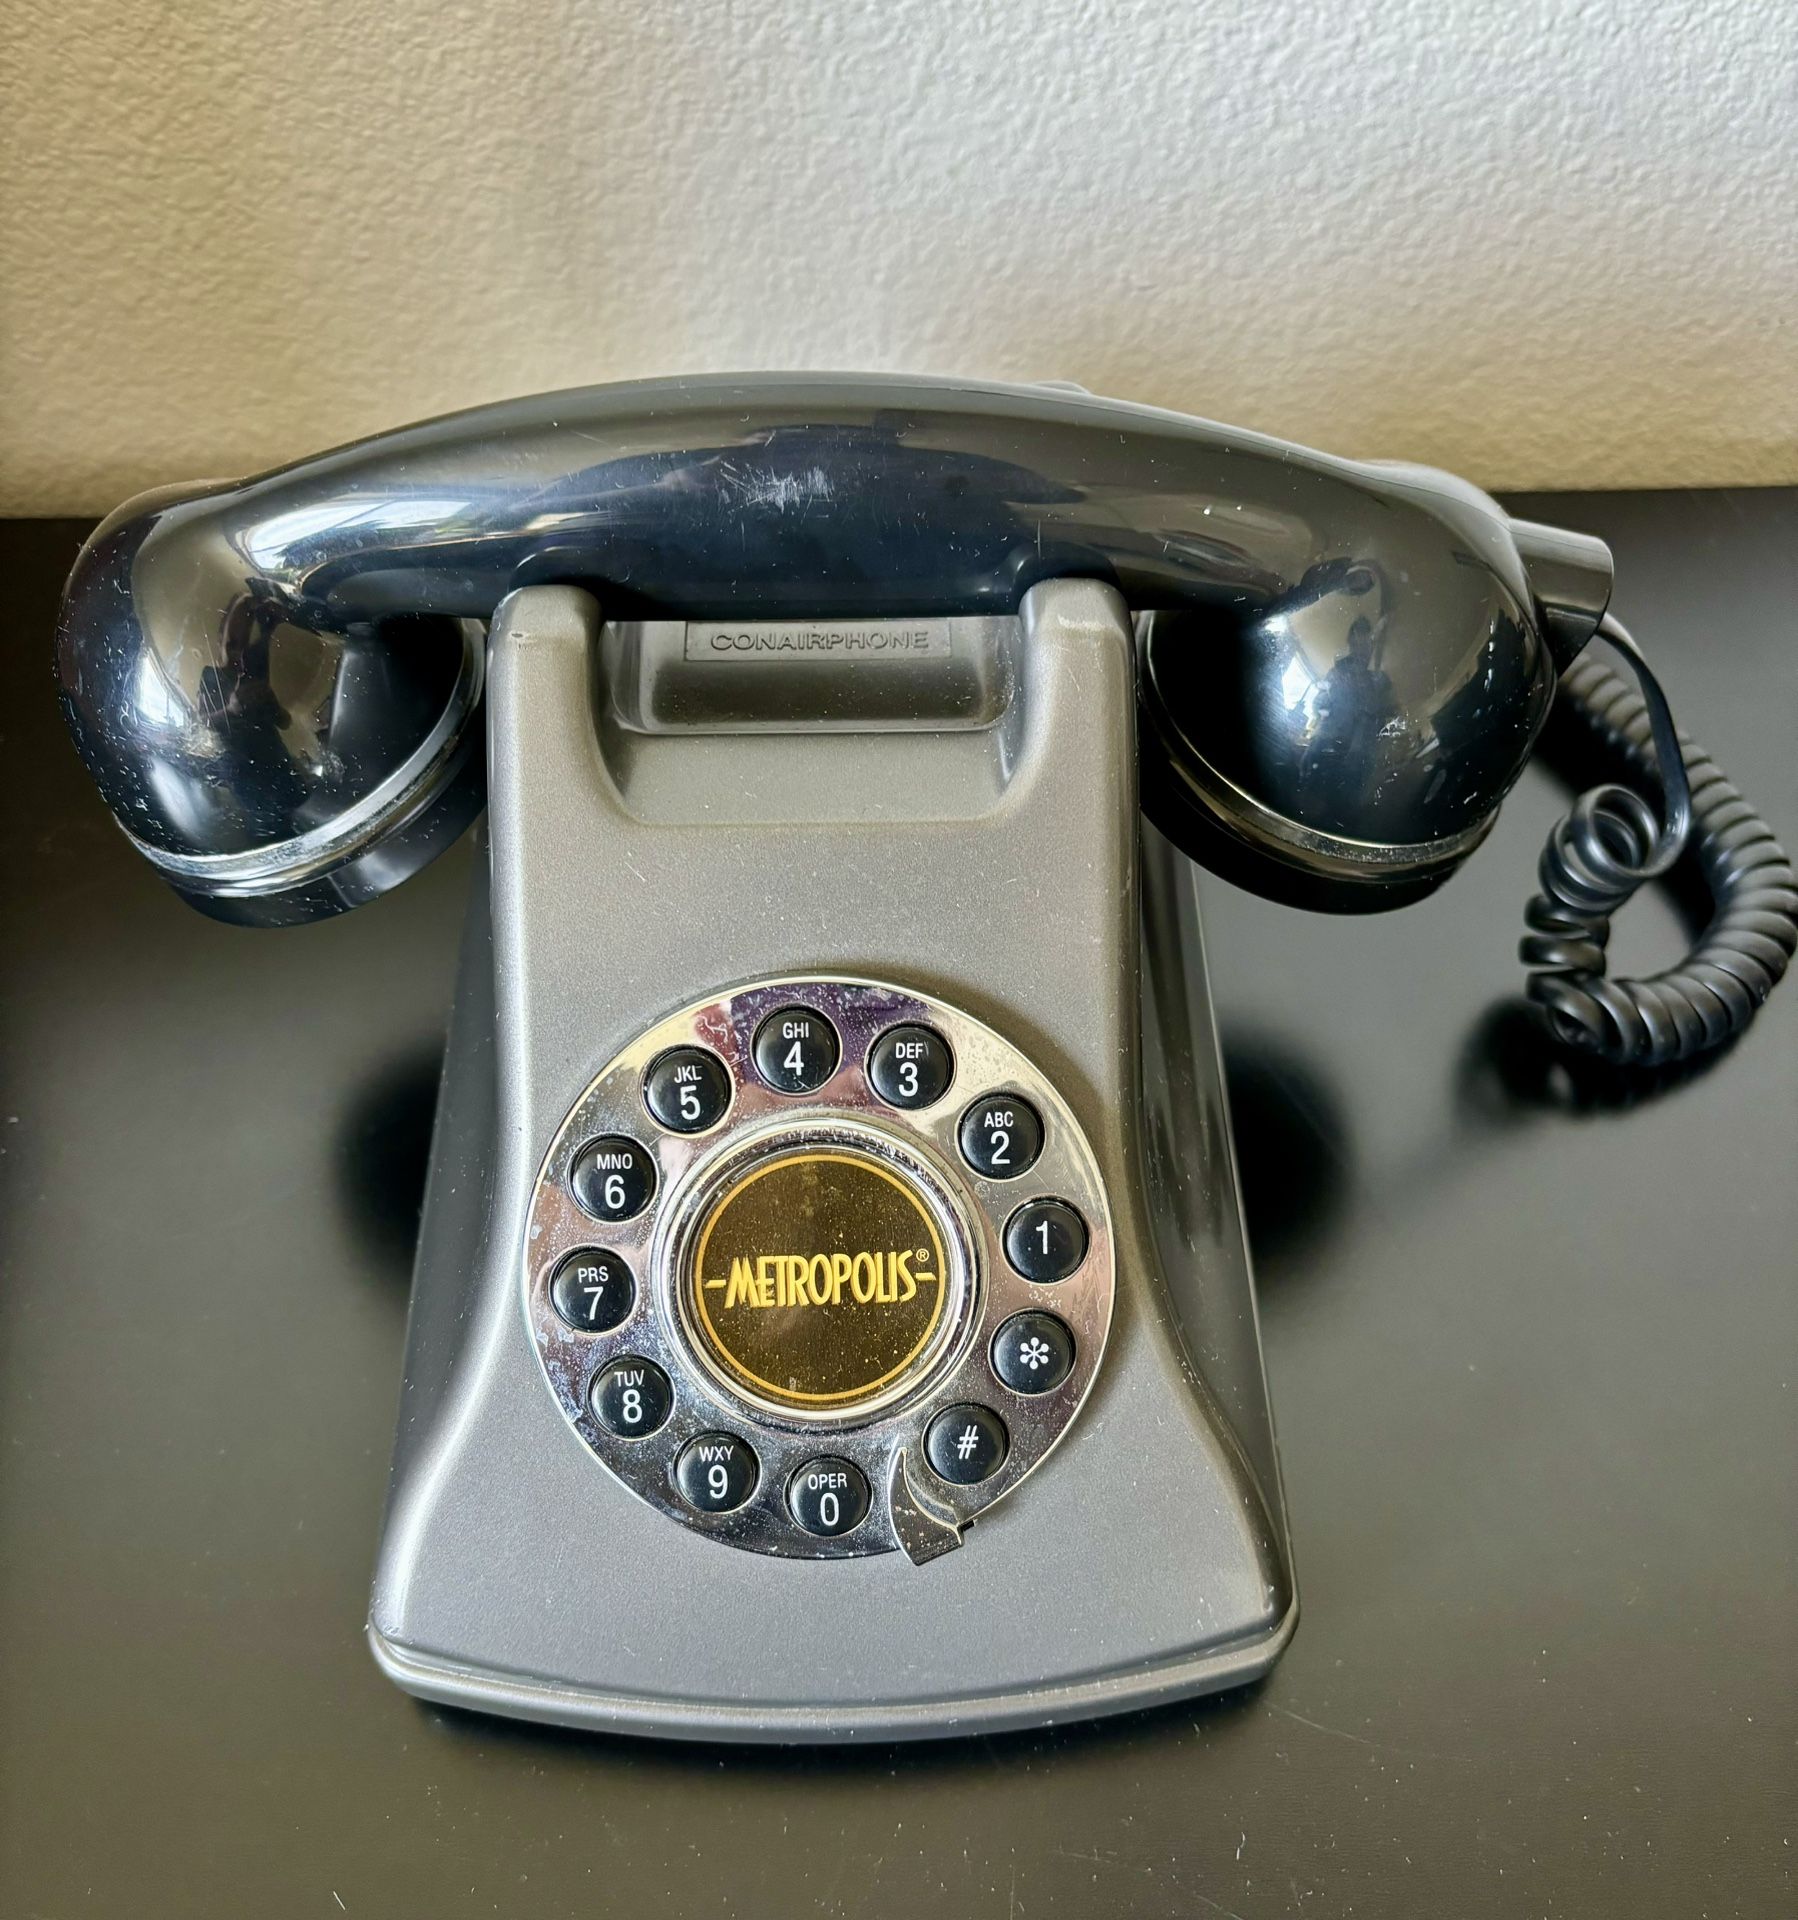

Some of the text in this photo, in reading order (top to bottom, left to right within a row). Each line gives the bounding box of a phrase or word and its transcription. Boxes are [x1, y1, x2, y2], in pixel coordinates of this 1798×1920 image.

[710, 631, 930, 651] CONAIRPHONE
[782, 1022, 809, 1039] GHI
[783, 1041, 804, 1076] 4
[895, 1042, 923, 1059] DEF
[674, 1064, 702, 1083] JKL
[898, 1062, 919, 1097] 3
[680, 1085, 701, 1120] 5
[984, 1111, 1014, 1128] ABC
[596, 1153, 633, 1170] MNO
[990, 1131, 1010, 1165] 2
[604, 1174, 626, 1209] 6
[1035, 1220, 1048, 1254] 1
[577, 1266, 609, 1283] PRS
[583, 1286, 604, 1321] 7
[614, 1369, 645, 1387] TUV
[622, 1389, 643, 1423] 8
[699, 1445, 734, 1462] WXY
[957, 1424, 979, 1460] #
[708, 1465, 729, 1499] 9
[808, 1472, 848, 1490] OPER
[820, 1492, 839, 1527] 0
